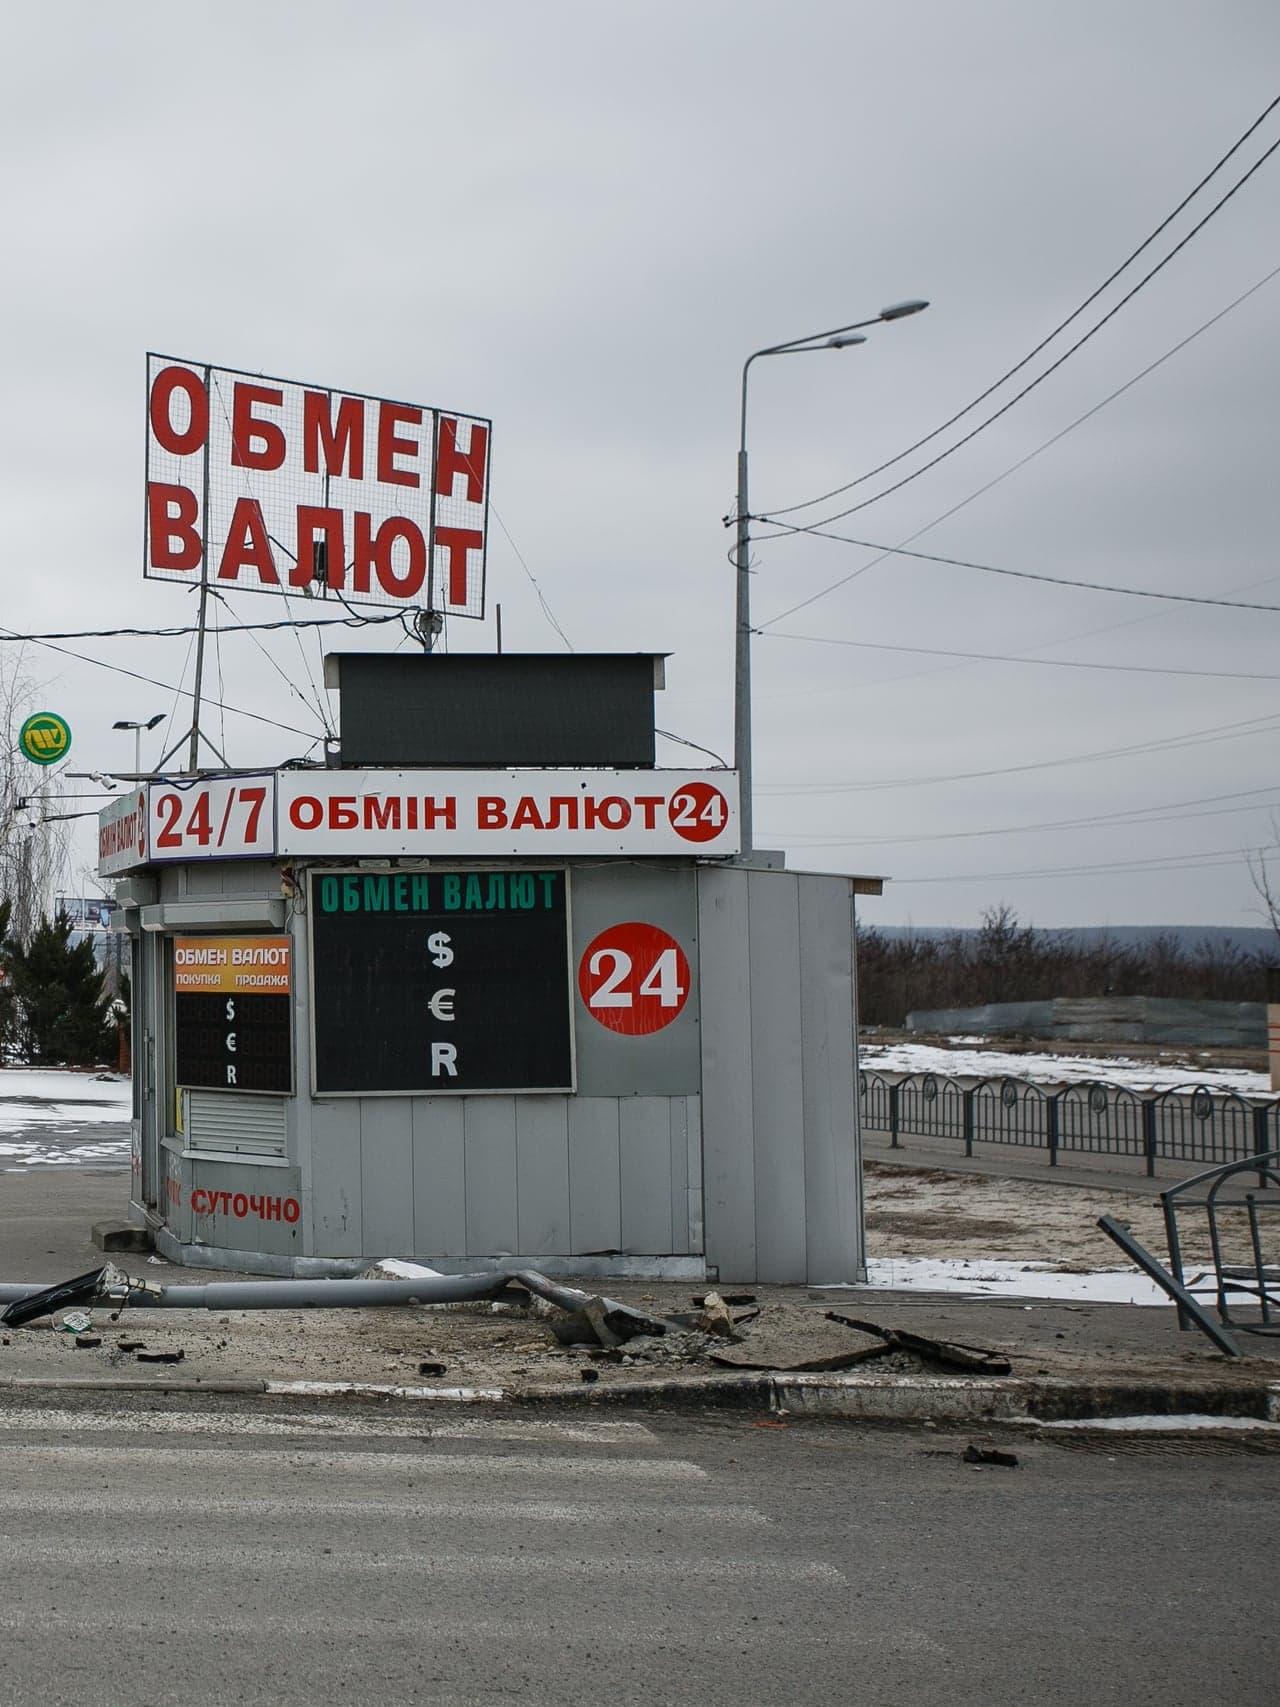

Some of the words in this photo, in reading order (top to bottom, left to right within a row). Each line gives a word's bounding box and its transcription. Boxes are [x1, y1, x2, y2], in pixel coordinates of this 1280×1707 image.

[150, 366, 487, 504] ОБМЕН
[148, 481, 483, 606] ВАЛЮТ
[157, 787, 266, 848] 24/7
[289, 796, 457, 830] ОБМІН
[477, 796, 665, 830] ВАЛЮТ
[673, 795, 726, 827] 24
[322, 876, 429, 912] ОБМЕН
[444, 873, 558, 911] ВАЛЮТ
[176, 948, 227, 965] ОБМЕН
[232, 948, 289, 965] ВАЛЮТ
[427, 931, 454, 968] $
[176, 974, 220, 985] ПОКУПКА
[235, 975, 288, 986] ПРОДАЖА
[589, 949, 684, 1008] 24
[227, 998, 235, 1021] $
[428, 988, 455, 1021] €
[226, 1033, 237, 1052] €
[431, 1043, 458, 1076] R
[227, 1065, 237, 1084] R
[191, 1189, 300, 1223] СУТОЧНО
